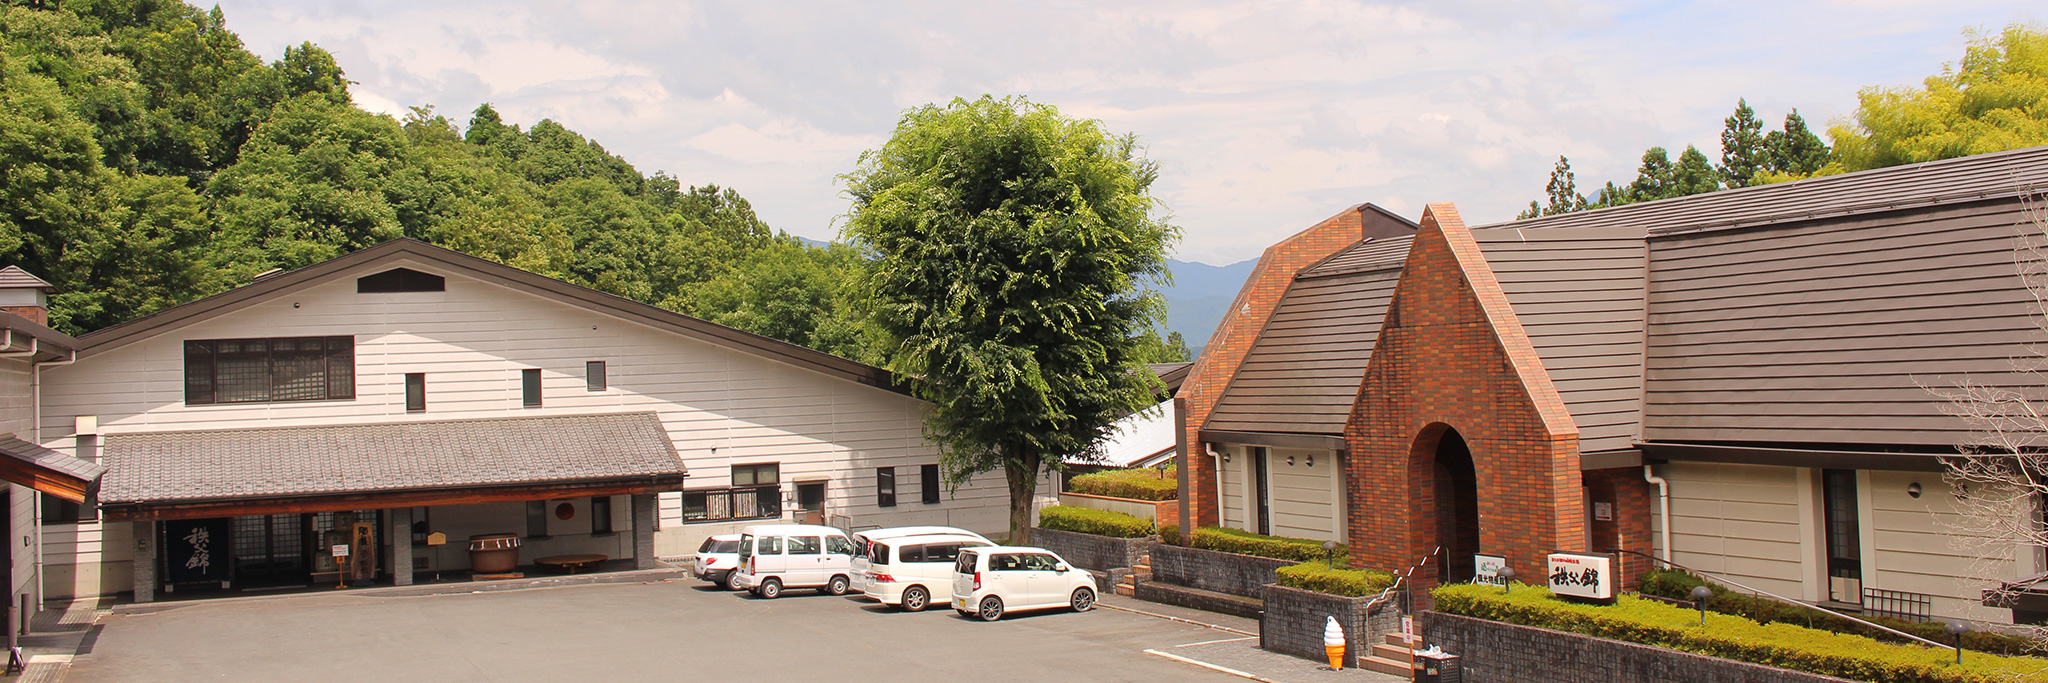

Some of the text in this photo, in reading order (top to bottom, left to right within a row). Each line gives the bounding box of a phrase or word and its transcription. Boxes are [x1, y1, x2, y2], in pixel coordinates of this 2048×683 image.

[182, 526, 210, 575] 秩父錦
[1549, 566, 1599, 594] 秩父錦
